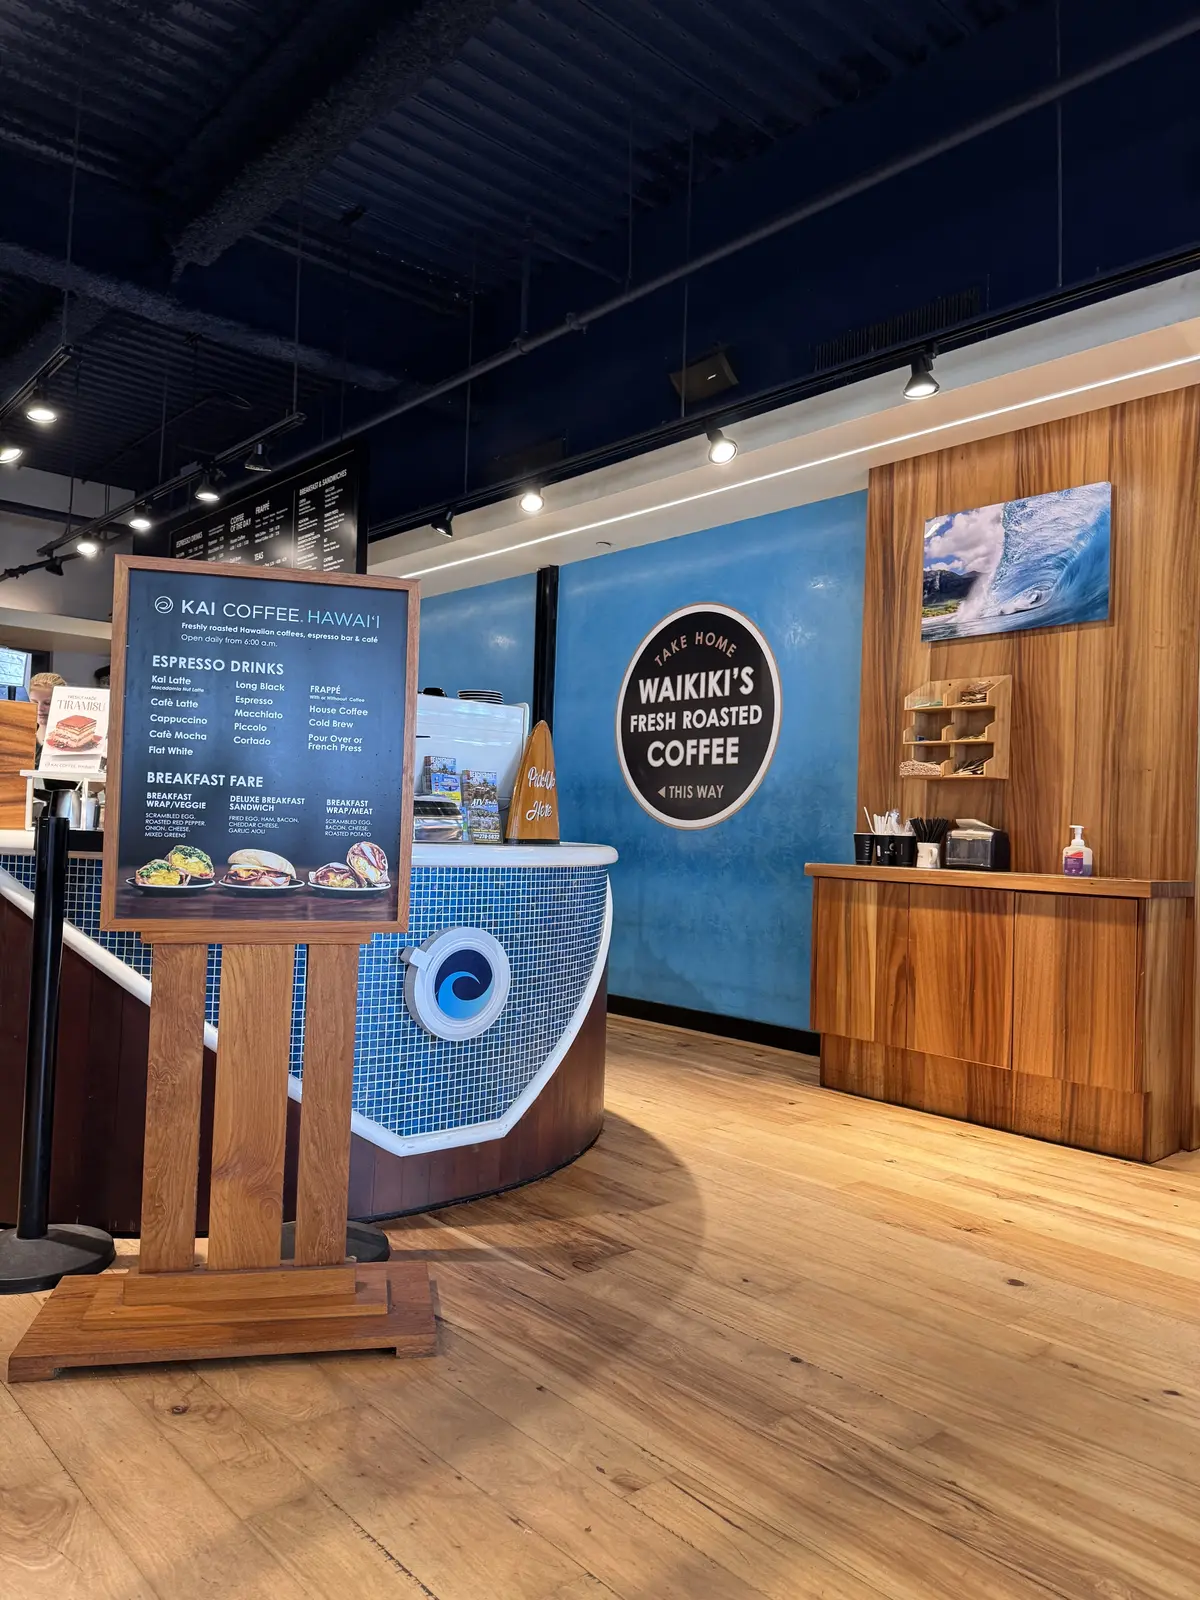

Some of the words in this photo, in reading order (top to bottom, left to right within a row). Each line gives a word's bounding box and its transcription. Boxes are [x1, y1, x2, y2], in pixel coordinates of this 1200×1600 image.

[181, 600, 215, 616] KAI
[182, 622, 207, 631] Freshly
[240, 627, 274, 635] Hawaiian
[276, 630, 305, 638] coffees,
[205, 636, 223, 644] daily
[654, 635, 687, 667] TAKE
[695, 632, 737, 658] HOME
[152, 655, 225, 672] ESPRESSO
[230, 661, 284, 675] DRINKS
[152, 675, 166, 683] Kai
[169, 676, 191, 685] Latte
[638, 666, 754, 704] WAIKIKI'S
[236, 681, 257, 691] Long
[260, 682, 285, 691] Black
[310, 685, 341, 694] FRAPPÉ
[57, 700, 106, 711] TIRAMISU
[176, 700, 198, 708] Latte
[235, 696, 273, 705] Espresso
[234, 709, 283, 719] Macchiato
[309, 705, 336, 714] House
[339, 707, 368, 716] Coffee
[150, 714, 208, 724] Cappuccino
[630, 712, 676, 732] FRESH
[682, 704, 763, 729] ROASTED
[234, 722, 267, 732] Piccolo
[309, 719, 330, 727] Cold
[332, 720, 353, 728] Brew
[175, 731, 207, 740] Mocha
[233, 736, 271, 745] Cortado
[330, 735, 351, 743] Over
[148, 746, 165, 754] Flat
[168, 747, 193, 756] White
[308, 743, 338, 751] French
[340, 744, 362, 752] Press
[647, 737, 739, 768] COFFEE
[147, 772, 225, 786] BREAKFAST
[230, 775, 263, 788] FARE
[146, 792, 192, 800] BREAKFAST
[669, 785, 693, 799] THIS
[697, 785, 724, 799] WAY
[146, 800, 206, 809] WRAP/VEGGIE
[262, 796, 305, 805] BREAKFAST
[326, 799, 368, 807] BREAKFAST
[326, 807, 373, 815] WRAP/MEAT
[526, 800, 552, 821] Here
